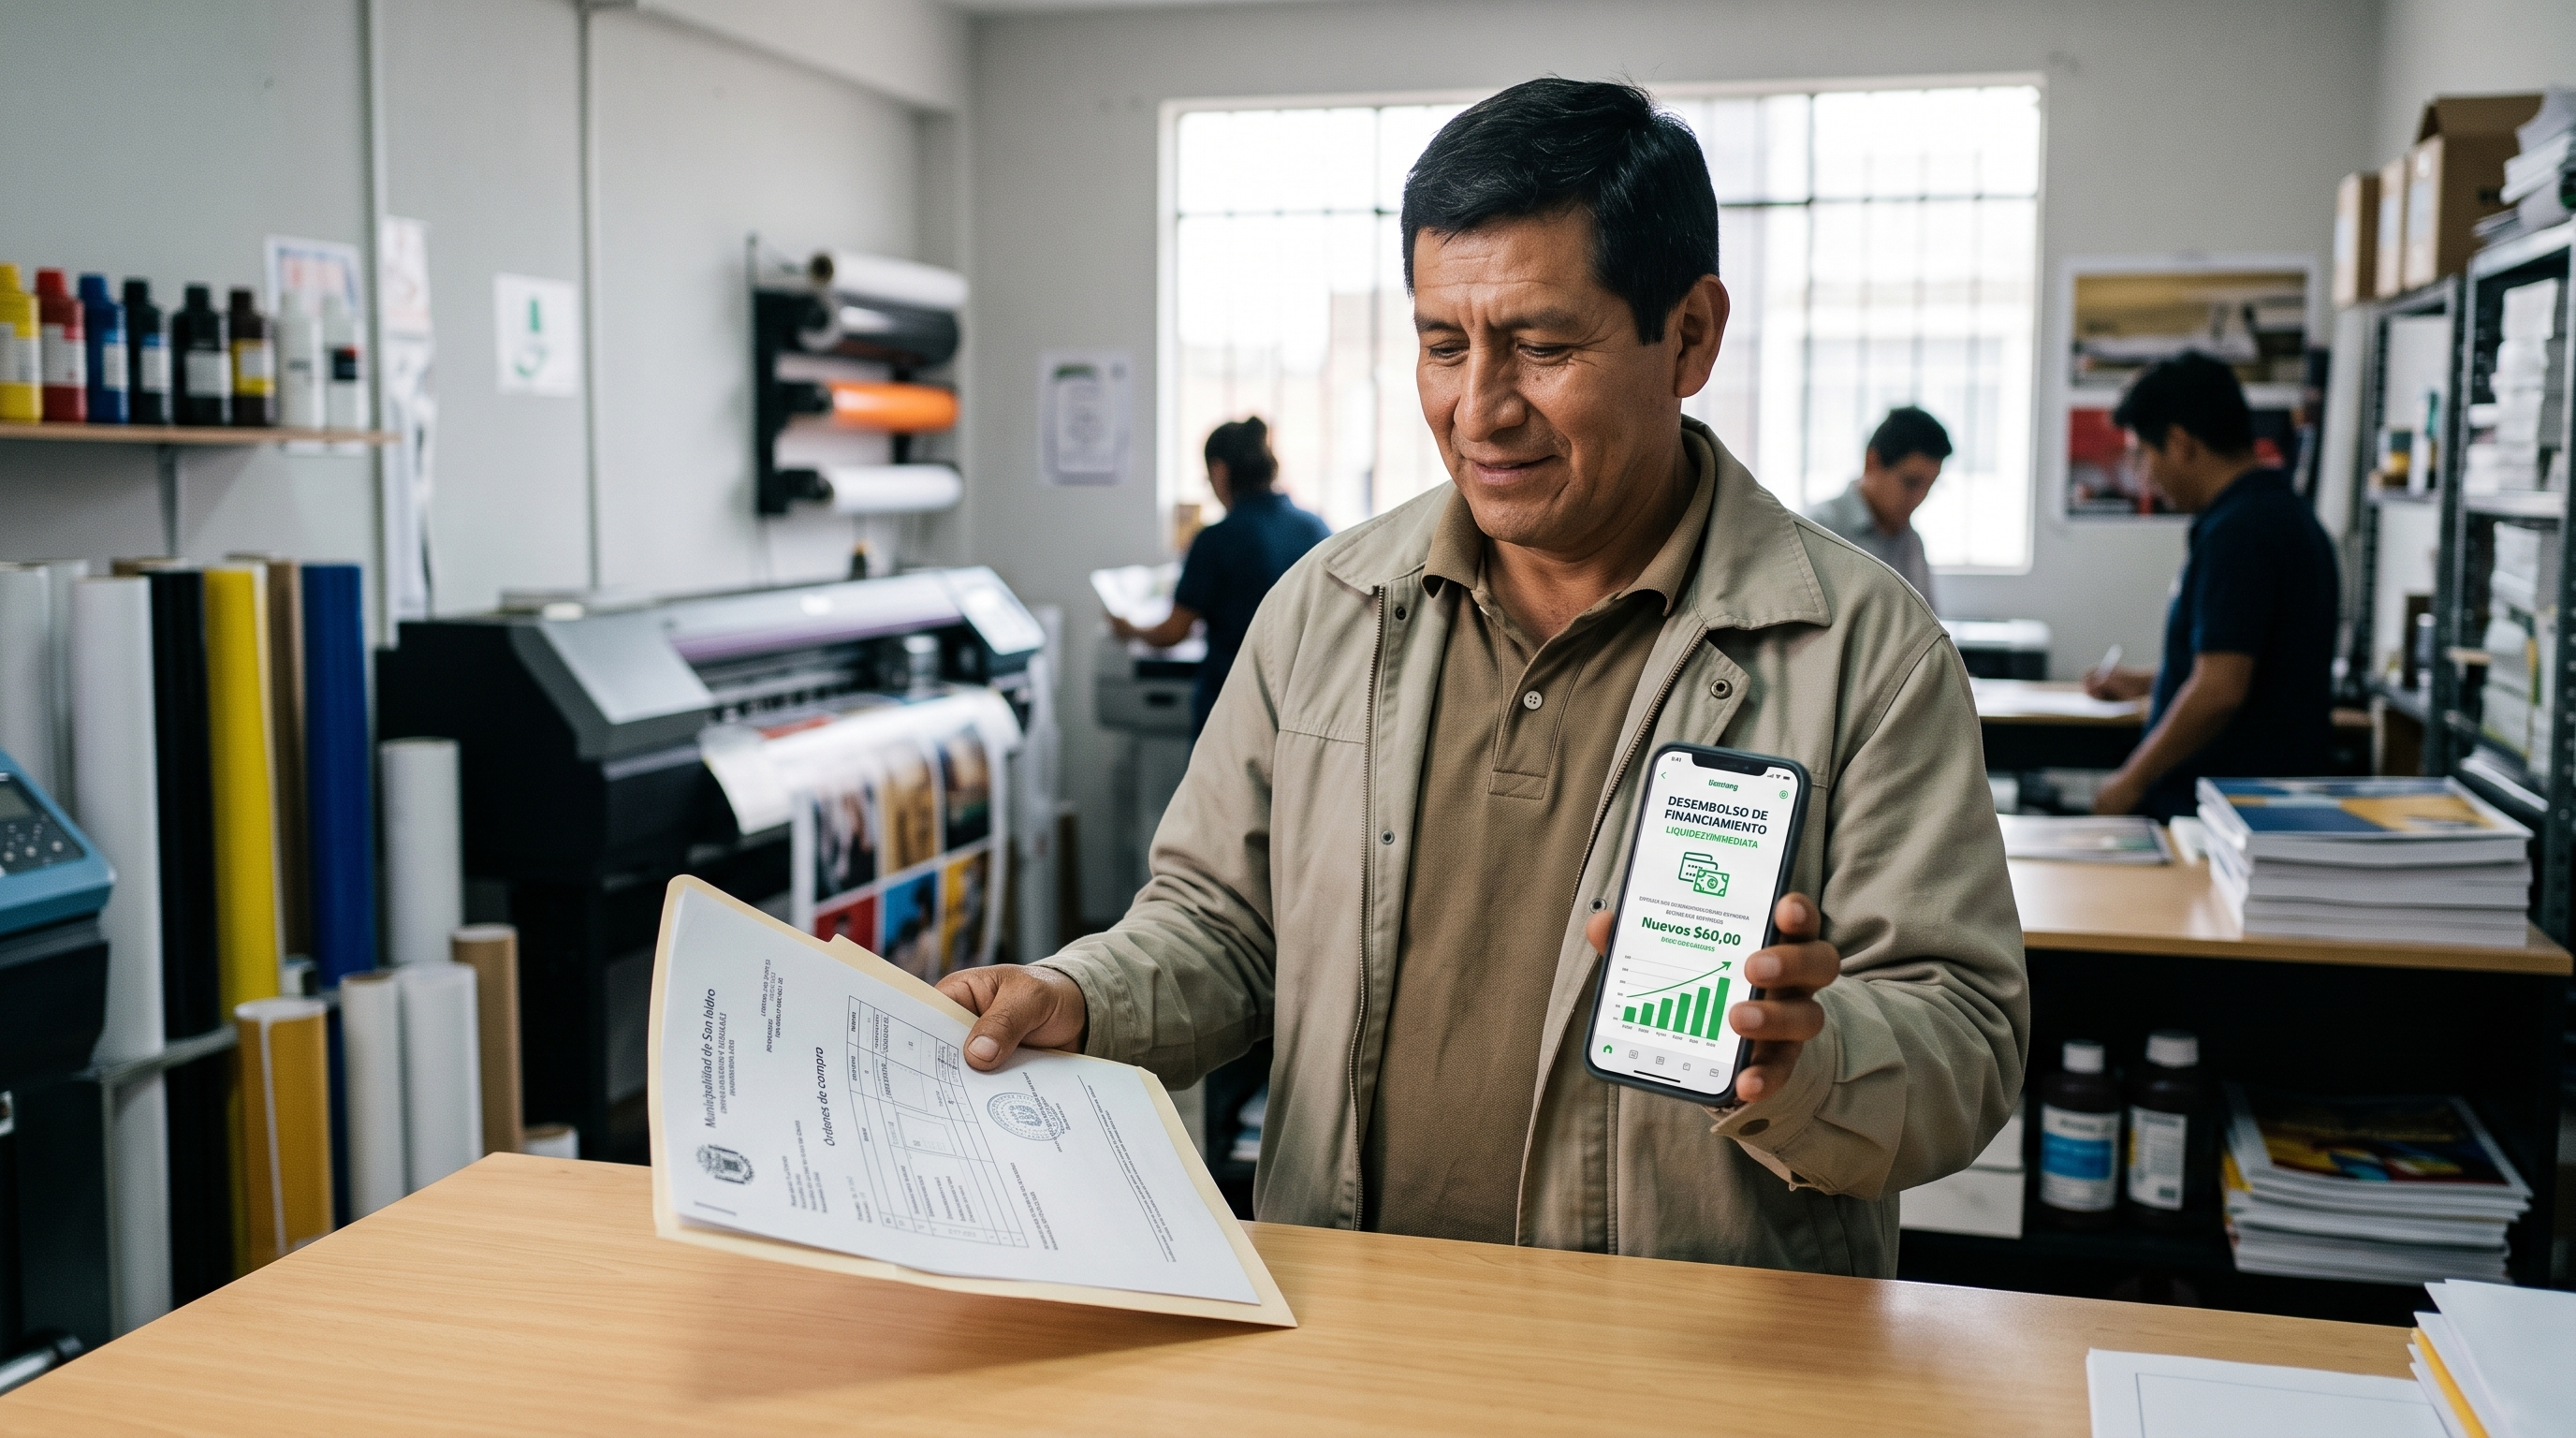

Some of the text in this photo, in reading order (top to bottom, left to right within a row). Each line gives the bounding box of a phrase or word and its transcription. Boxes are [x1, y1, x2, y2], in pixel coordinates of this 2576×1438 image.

[1668, 796, 1769, 821] DESEMBOLSO DE
[1664, 809, 1767, 835] FINANCIAMIENTO
[1641, 917, 1691, 936] Nuevos
[1692, 926, 1742, 946] $60,00
[701, 1043, 712, 1058] de
[816, 1090, 828, 1106] de
